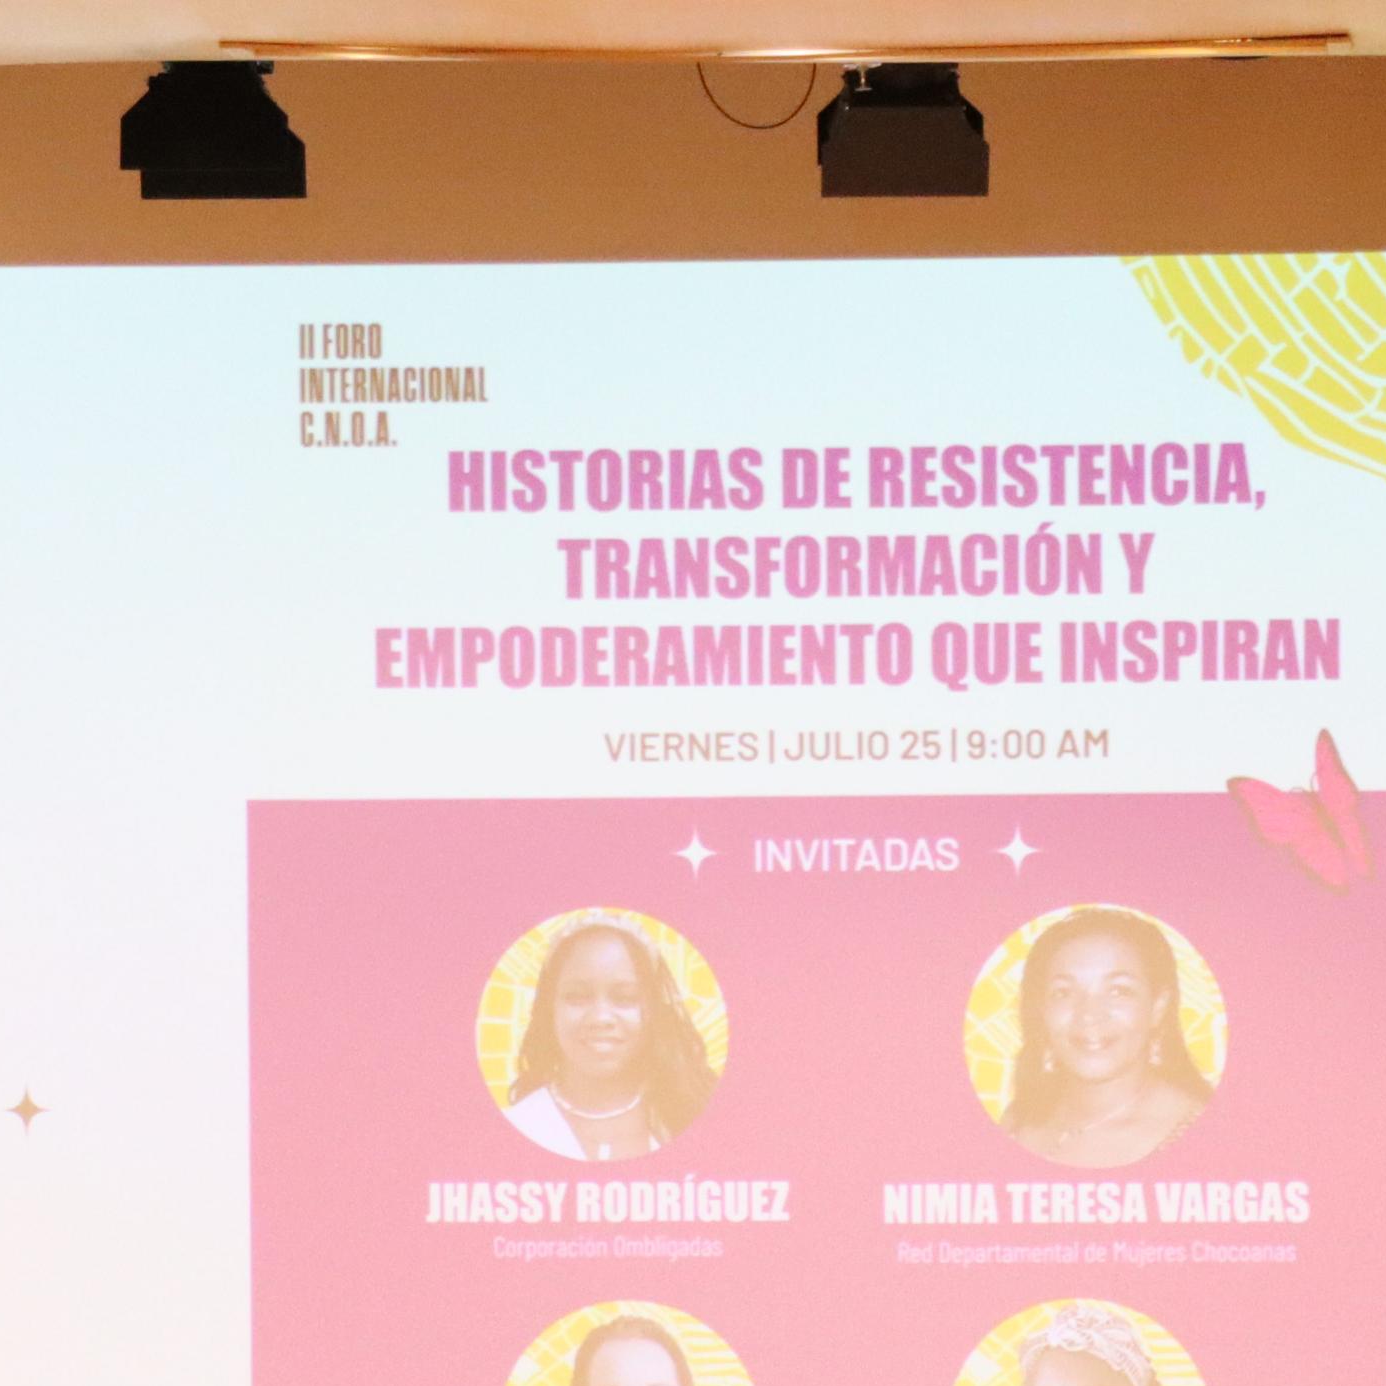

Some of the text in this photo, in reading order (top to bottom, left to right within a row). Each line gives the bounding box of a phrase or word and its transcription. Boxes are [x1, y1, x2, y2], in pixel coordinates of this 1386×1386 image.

[299, 323, 382, 359] II FORO
[299, 366, 488, 403] INTERNACIONAL
[300, 411, 397, 447] C.N.O.A.
[448, 442, 1265, 512] HISTORIAS DE RESISTENCIA,
[557, 521, 1155, 599] TRANSFORMACIÓN Y
[375, 618, 1340, 691] EMPODERAMIENTO QUE INSPIRAN
[604, 731, 759, 762] VIERNES
[784, 730, 889, 761] JULIO
[900, 730, 941, 760] 25
[966, 728, 1046, 759] 9:00
[1056, 729, 1109, 758] AM
[754, 837, 960, 872] INVITADAS
[425, 1174, 790, 1223] JHASSY RODRÍGUEZ
[883, 1181, 1310, 1224] NIMIA TERESA VARGAS
[493, 1235, 723, 1262] Corporación Ombligadas
[897, 1241, 1297, 1267] Red Departamental de Mujeres Chocoanas
